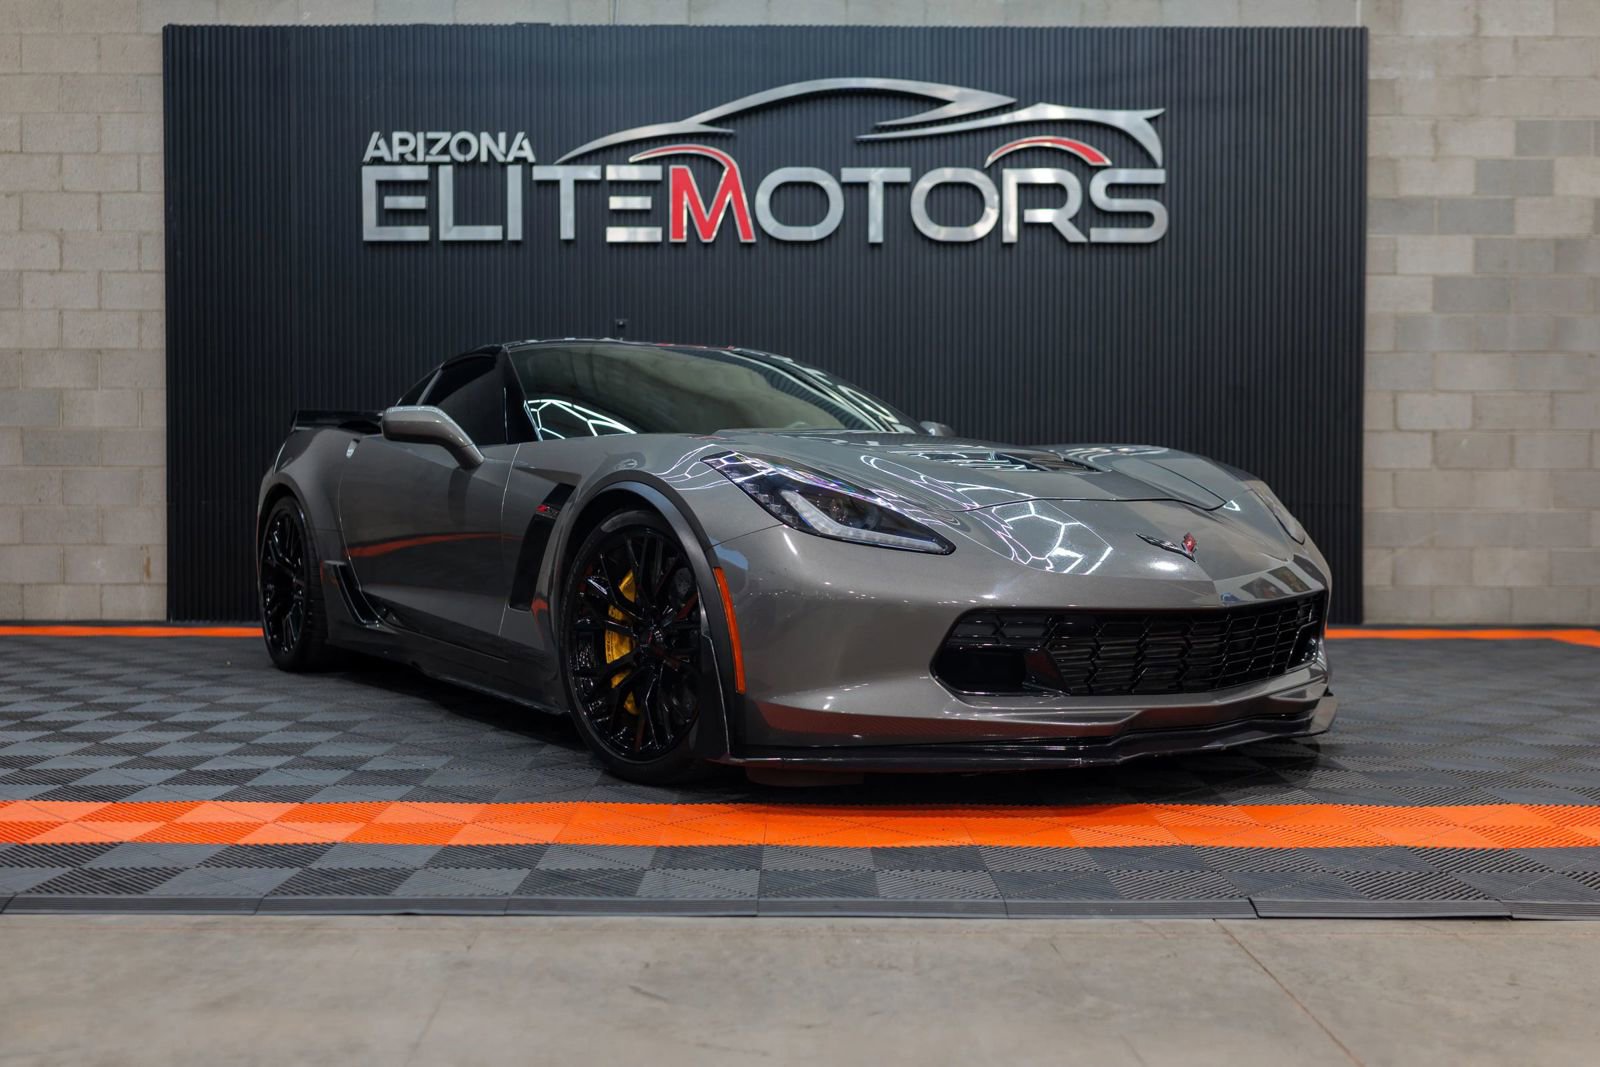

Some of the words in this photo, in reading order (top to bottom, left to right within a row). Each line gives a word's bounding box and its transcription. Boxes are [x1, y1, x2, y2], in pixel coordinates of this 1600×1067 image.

[362, 131, 536, 163] ARIZONA
[362, 164, 662, 242] ELITE
[669, 164, 1168, 243] MOTORS
